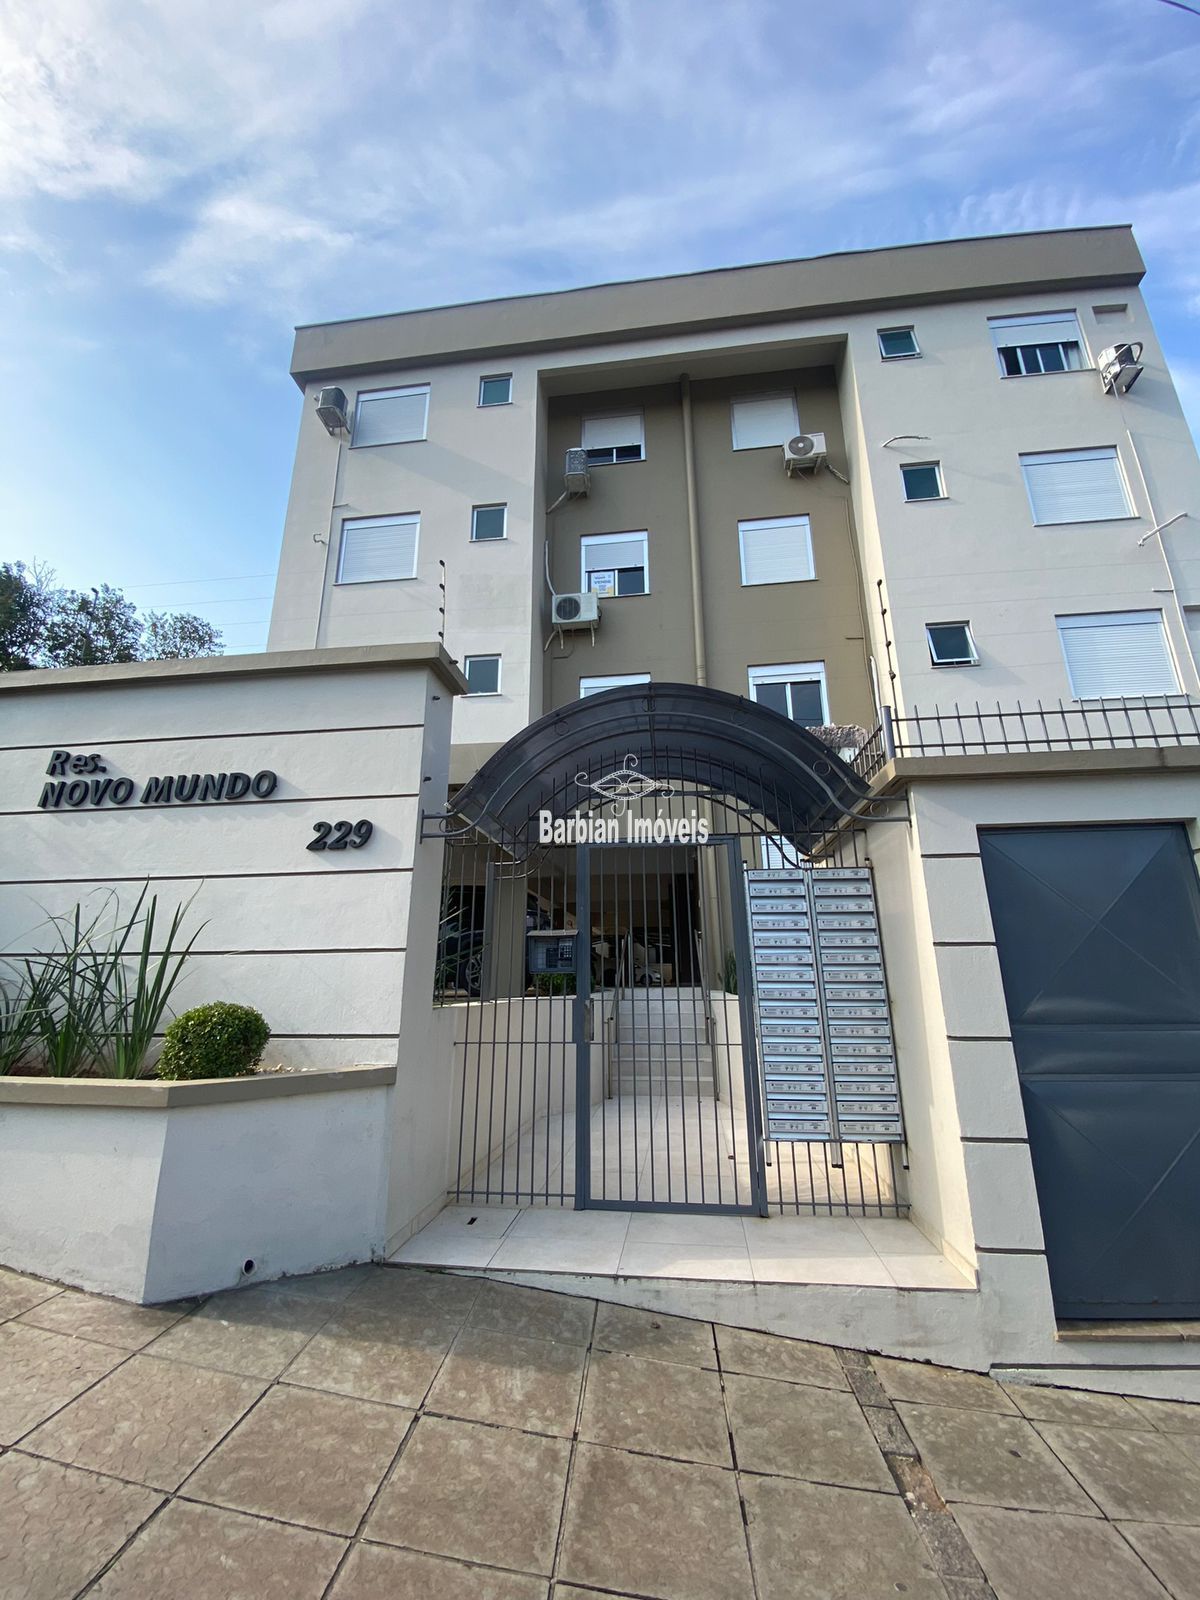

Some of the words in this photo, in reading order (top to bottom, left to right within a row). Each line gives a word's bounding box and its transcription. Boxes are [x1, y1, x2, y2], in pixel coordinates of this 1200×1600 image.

[46, 750, 107, 777] Res.
[37, 777, 134, 809] NOVO
[140, 770, 278, 804] MUNDO
[306, 819, 374, 851] 229
